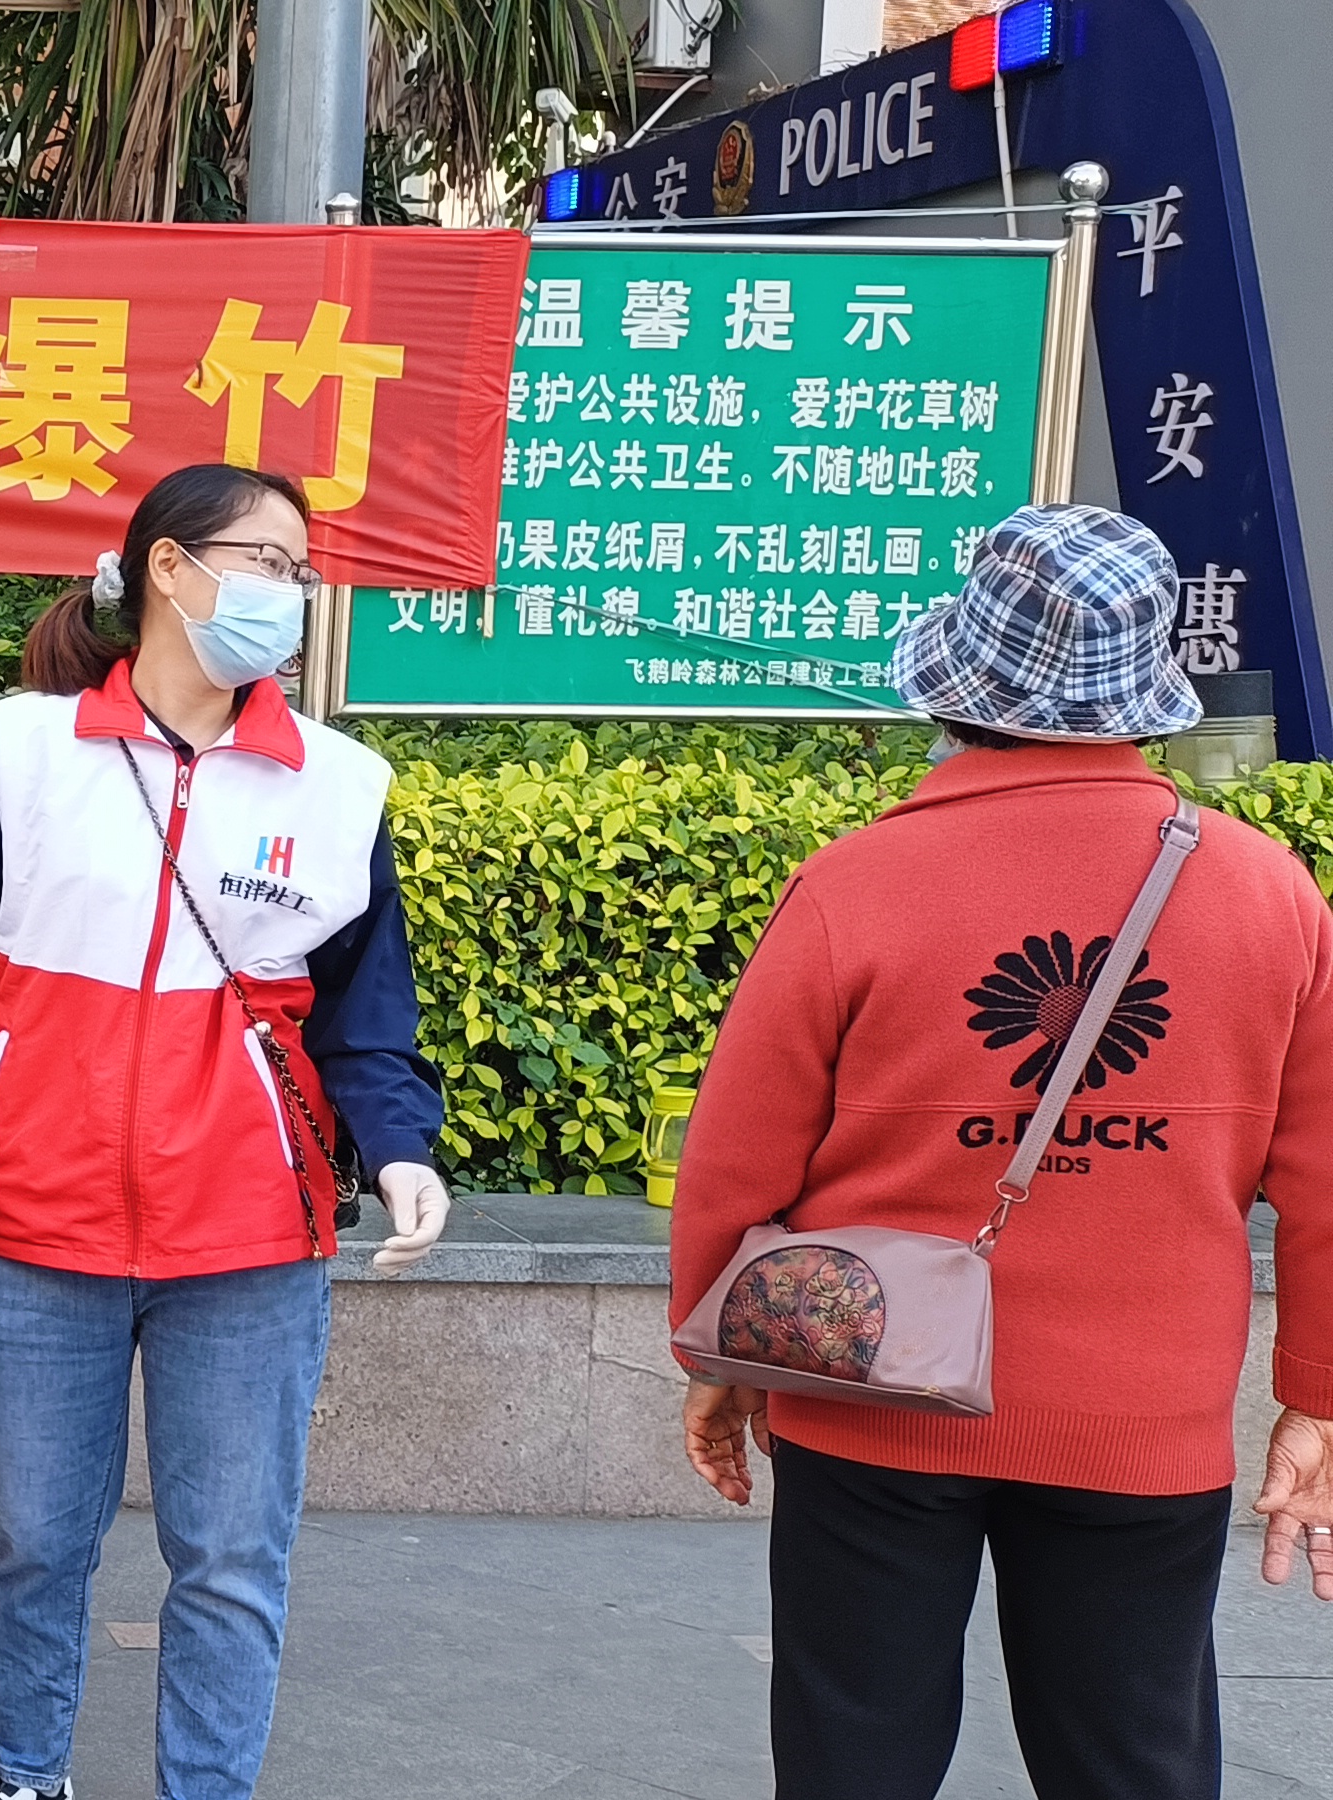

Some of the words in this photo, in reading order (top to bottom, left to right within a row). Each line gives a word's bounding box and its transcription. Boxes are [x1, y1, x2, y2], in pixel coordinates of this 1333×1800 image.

[604, 155, 688, 233] 公安
[779, 71, 937, 197] POLICE
[515, 278, 914, 352] 温馨提示
[219, 872, 314, 914] 恒洋社工
